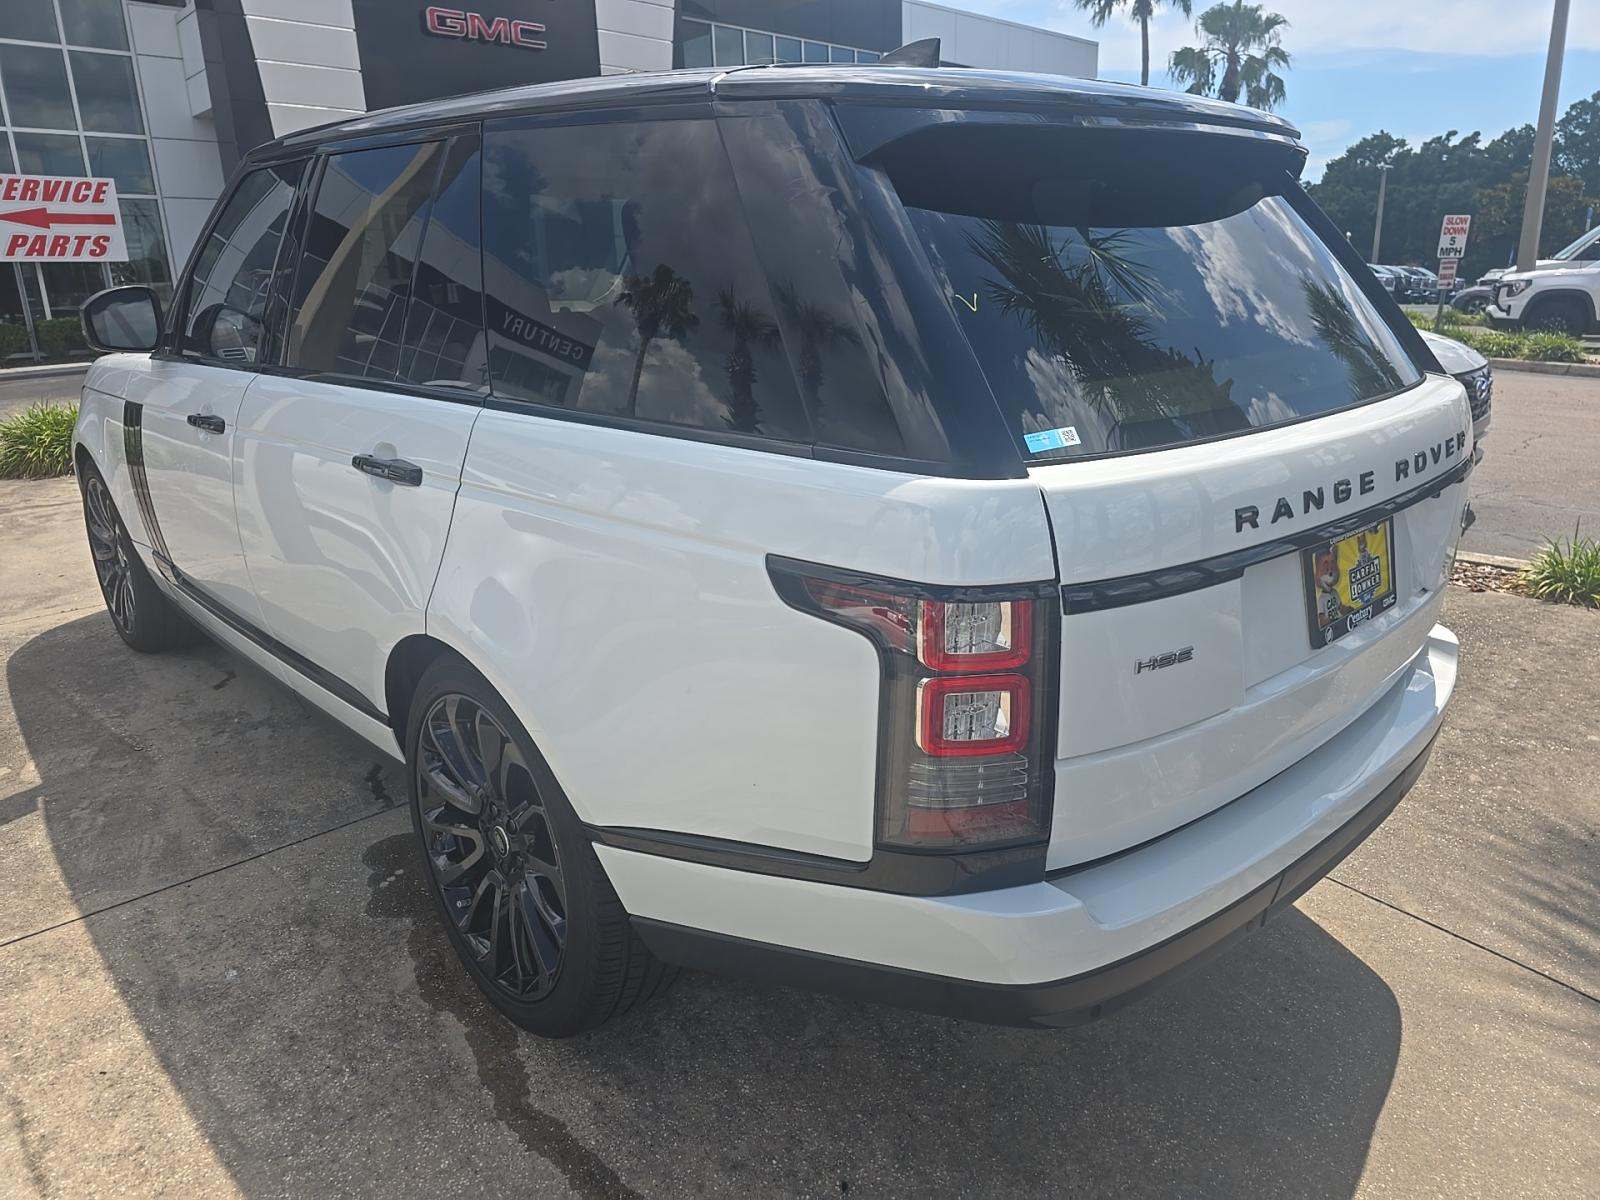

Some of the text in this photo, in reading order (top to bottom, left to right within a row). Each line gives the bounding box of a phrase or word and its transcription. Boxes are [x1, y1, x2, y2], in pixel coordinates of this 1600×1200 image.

[425, 6, 547, 49] GMC
[1445, 216, 1469, 225] SLOW
[1443, 226, 1467, 235] DOWN
[5, 234, 111, 257] PARTS
[1449, 236, 1456, 246] 5
[1439, 247, 1462, 256] MPH
[1234, 430, 1466, 533] RANGE ROVER
[1134, 645, 1194, 675] HSE
